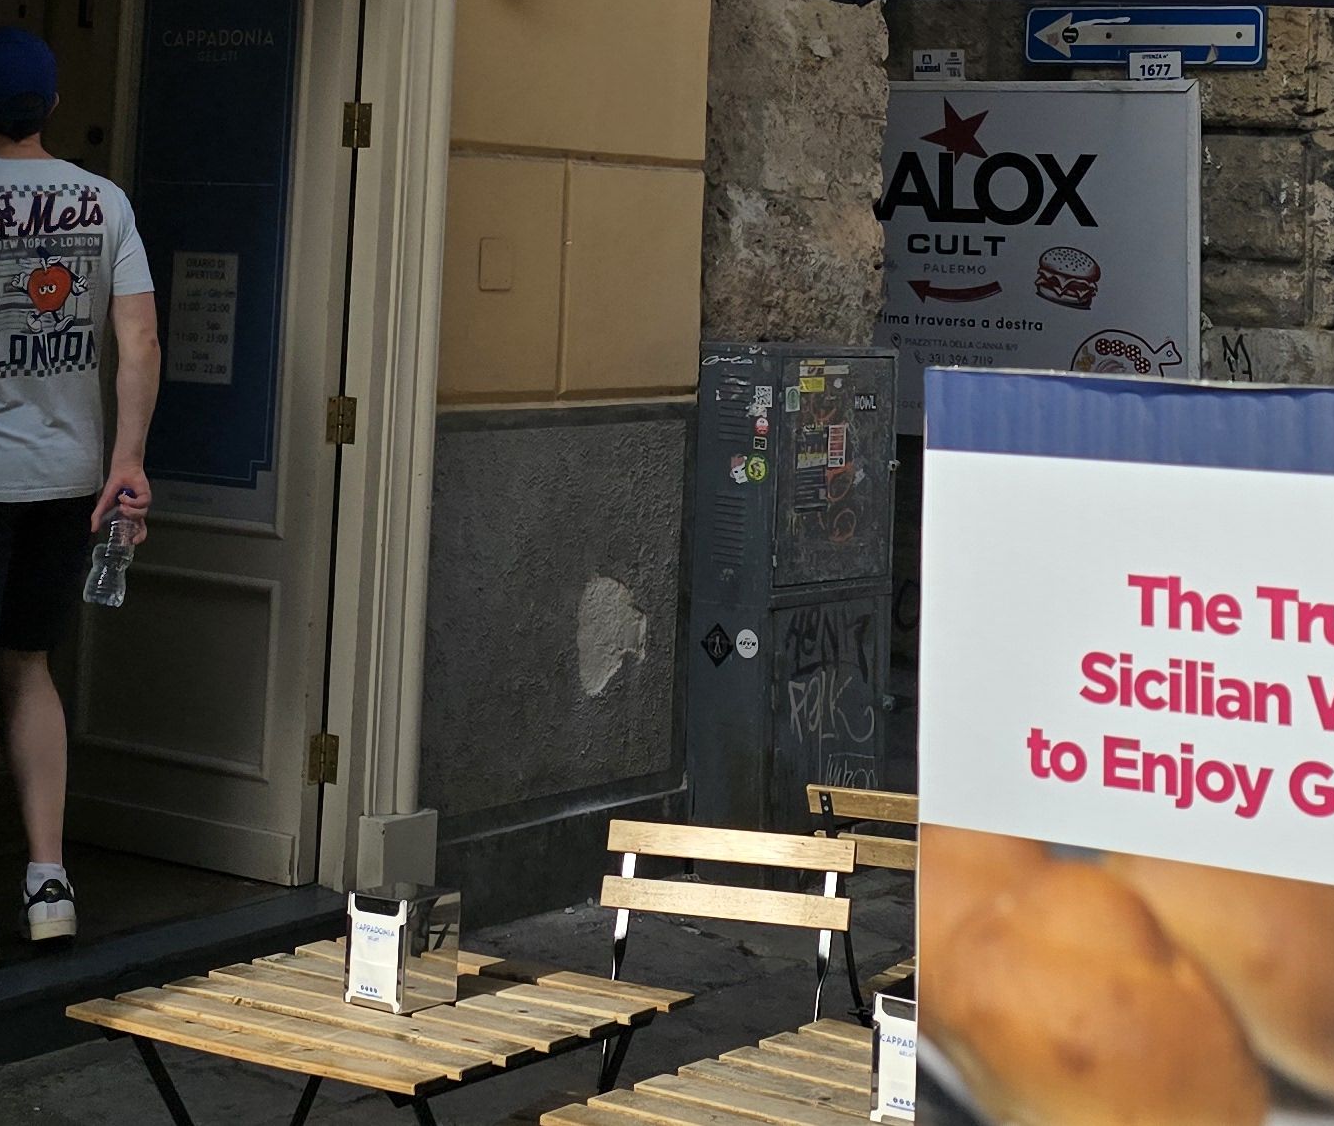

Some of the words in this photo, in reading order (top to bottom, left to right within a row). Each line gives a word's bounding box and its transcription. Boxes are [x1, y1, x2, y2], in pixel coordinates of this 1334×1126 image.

[161, 28, 275, 47] CAPPADONIA
[1139, 63, 1172, 77] 1677
[874, 150, 1099, 228] ALOX
[17, 186, 104, 237] Mets
[22, 237, 47, 249] YORK
[60, 236, 101, 248] LONDON
[906, 233, 1006, 257] CULT
[923, 262, 987, 276] PALERMO
[915, 314, 976, 328] traversa
[981, 319, 990, 328] a
[995, 316, 1044, 332] destra
[904, 337, 948, 348] PIAZZETTA
[949, 339, 974, 349] DELLA
[975, 341, 1004, 350] CANNA
[928, 353, 945, 364] 331
[1127, 573, 1243, 637] The
[1078, 651, 1292, 727] Sicilian
[1026, 727, 1088, 783] to
[1102, 734, 1273, 820] Enjoy
[355, 921, 396, 937] CAPPADONIA
[880, 1033, 916, 1049] CAPPAD
